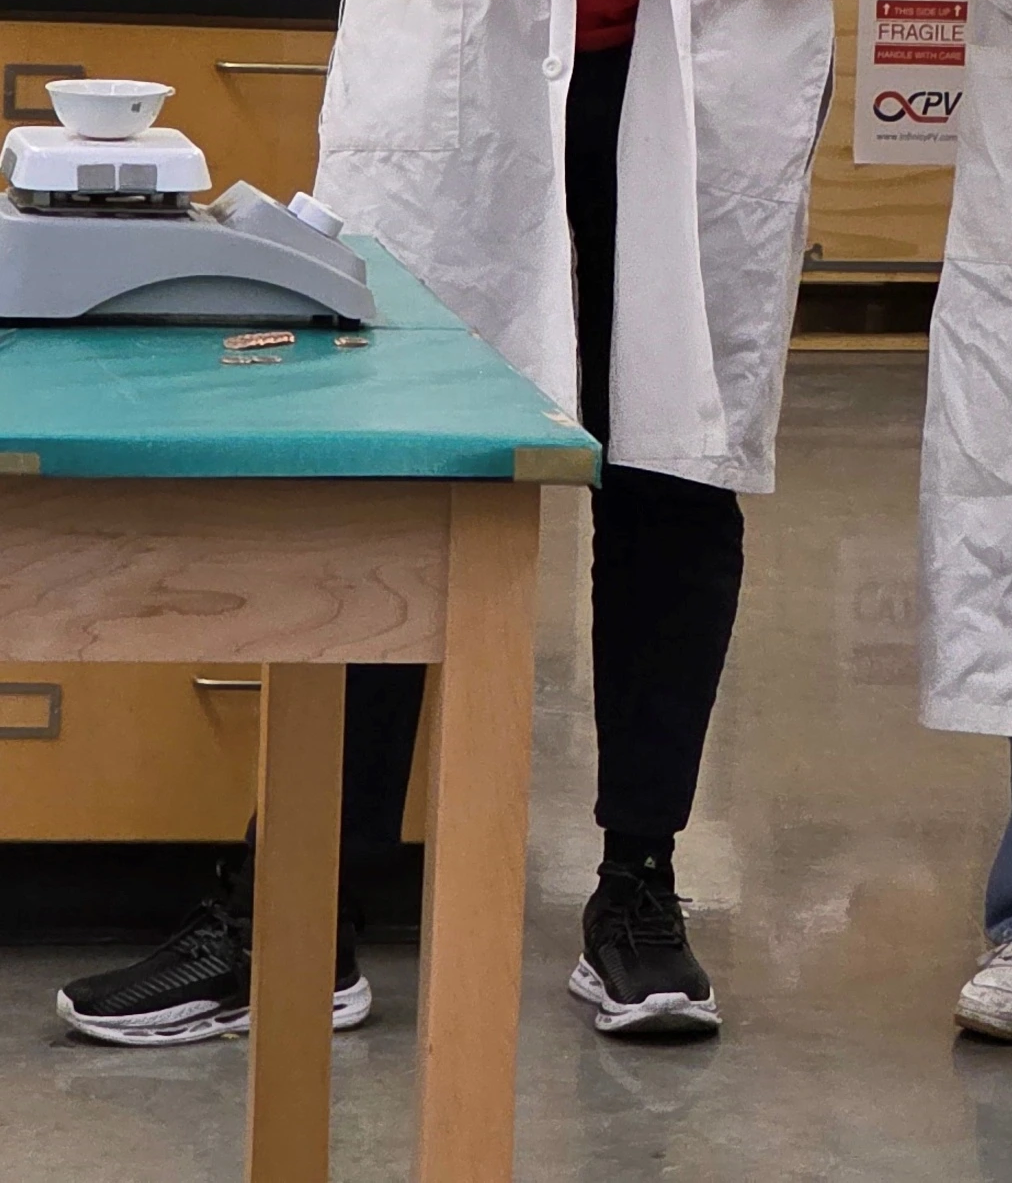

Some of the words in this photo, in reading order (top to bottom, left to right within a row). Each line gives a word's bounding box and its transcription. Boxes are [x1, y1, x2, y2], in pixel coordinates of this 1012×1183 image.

[894, 7, 914, 16] THIS
[939, 8, 951, 17] UP
[878, 23, 965, 42] FRAGILE
[877, 50, 913, 60] HANDLE
[914, 51, 937, 60] WITH
[939, 51, 962, 61] CARE
